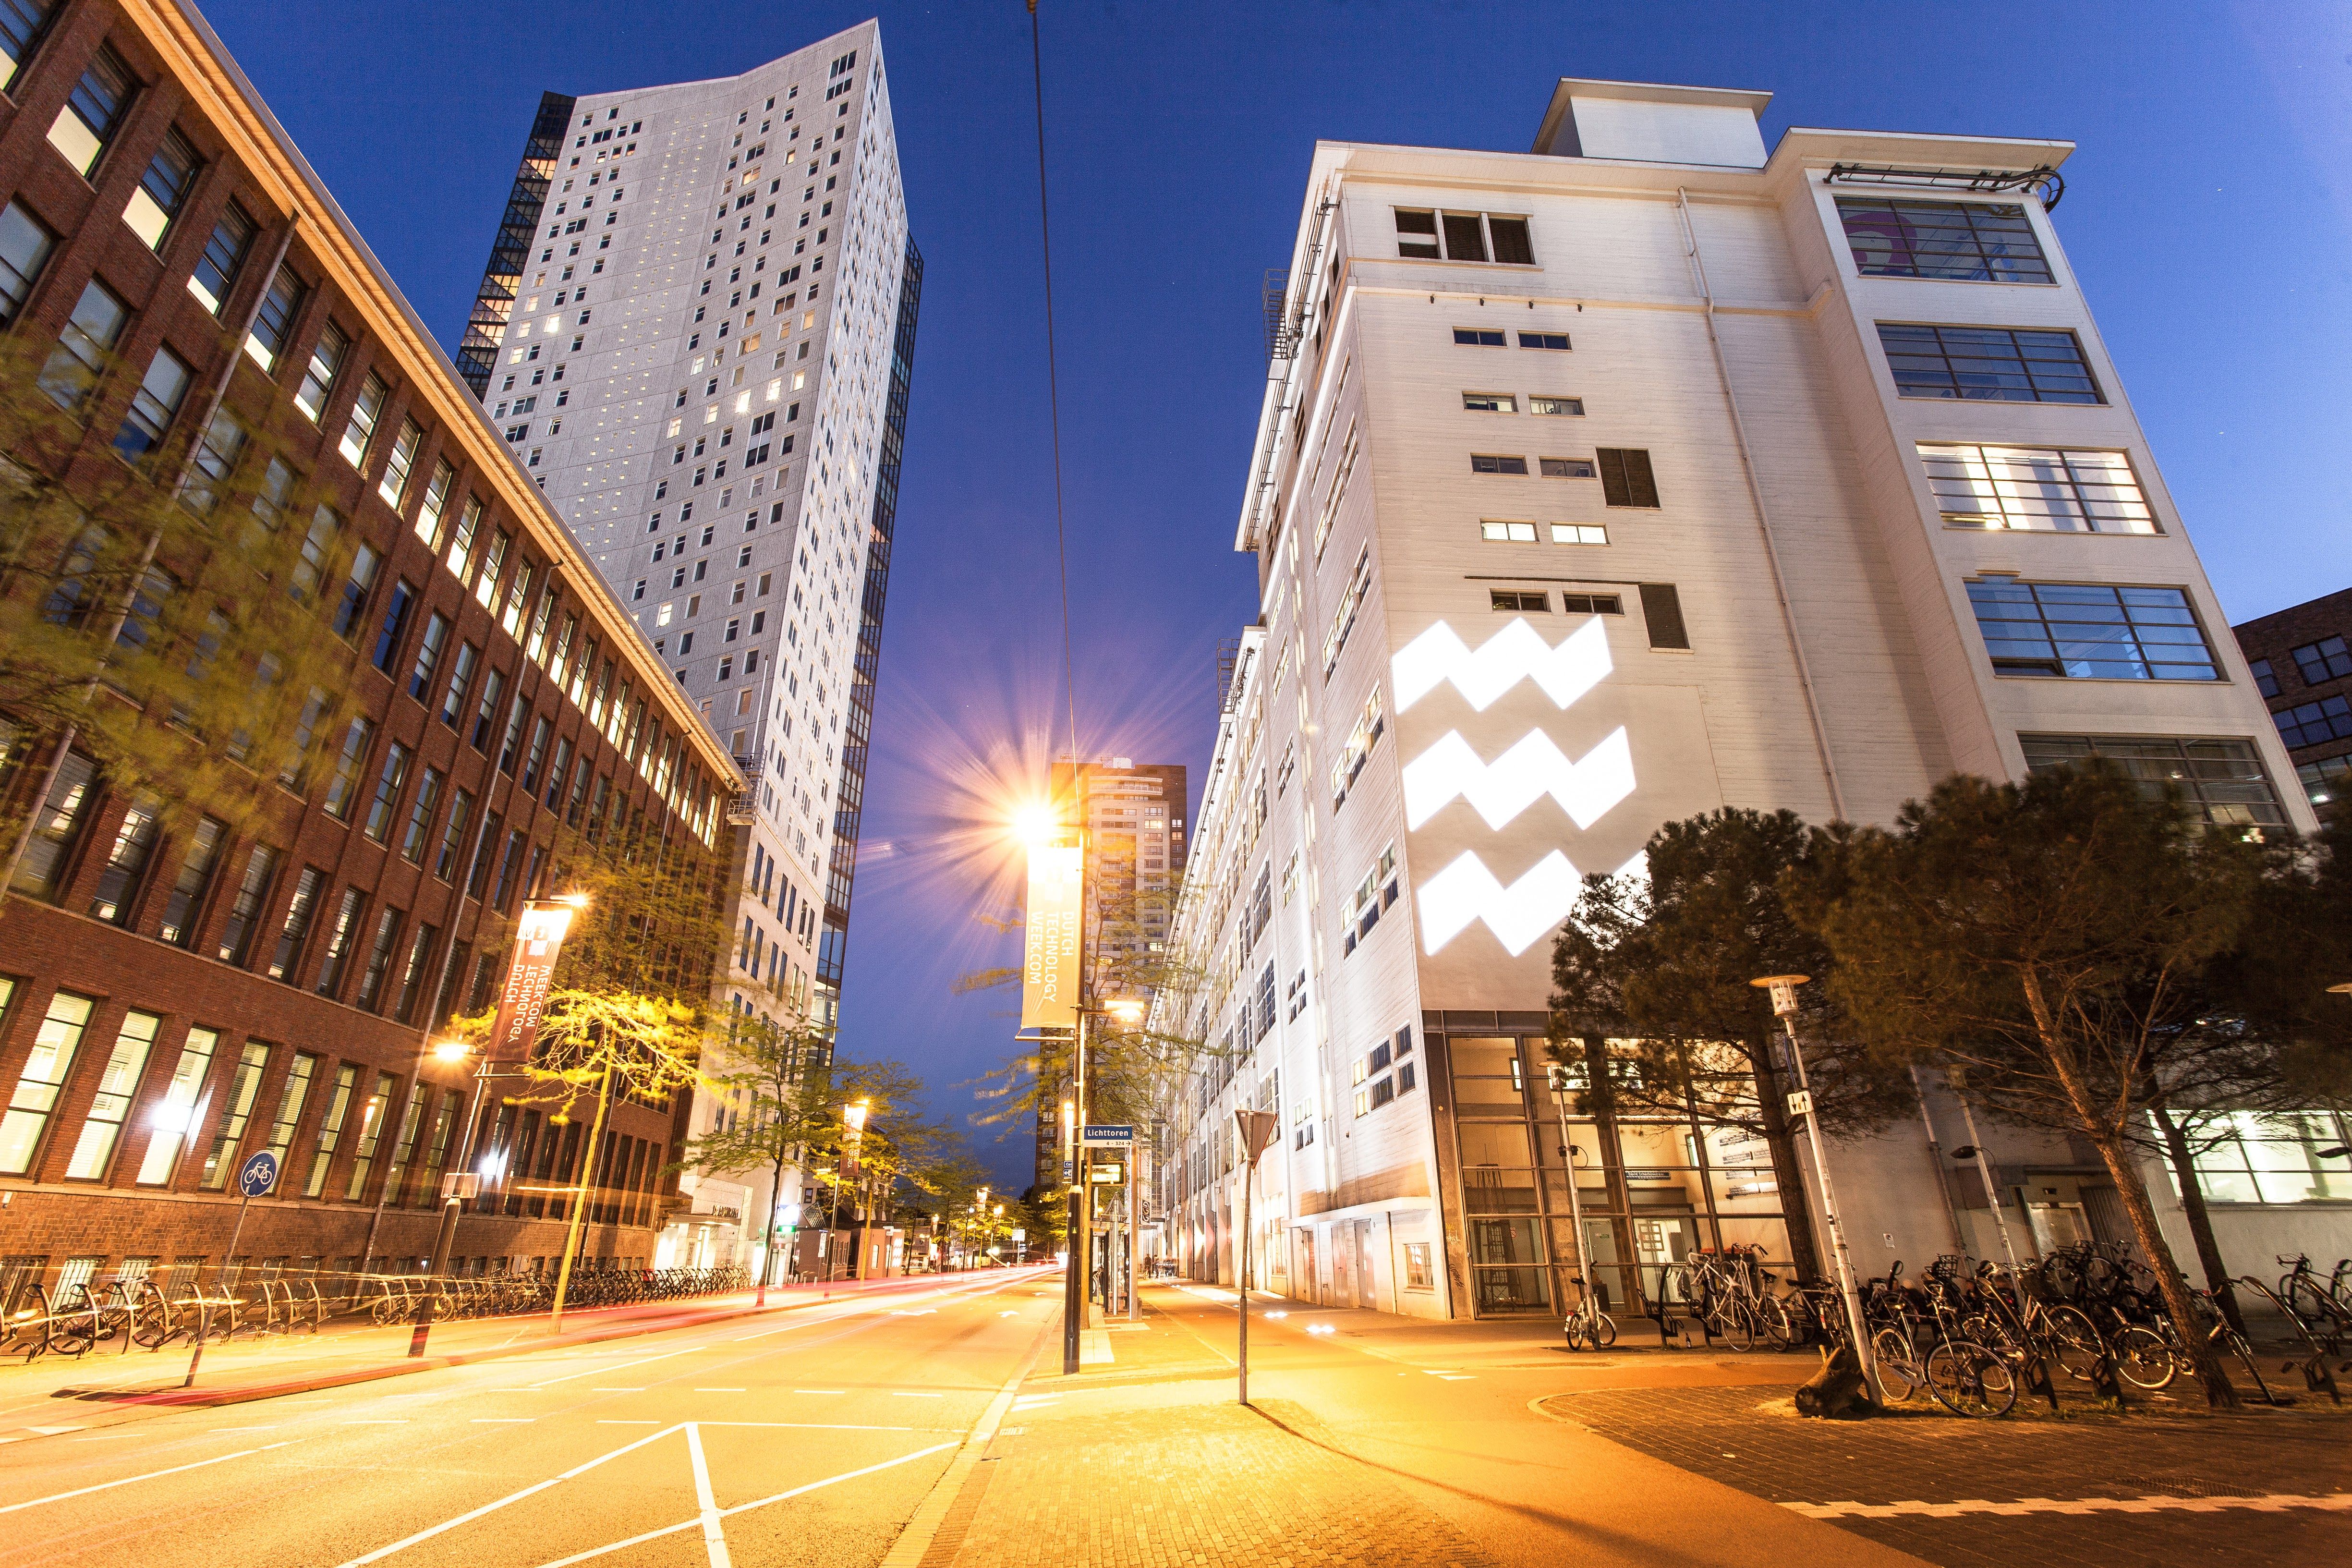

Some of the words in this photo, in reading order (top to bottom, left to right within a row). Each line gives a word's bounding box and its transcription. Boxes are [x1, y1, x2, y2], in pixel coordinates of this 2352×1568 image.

[1029, 911, 1043, 984] WEEK.COM
[1044, 912, 1059, 1002] TECHNOLOGY
[1062, 912, 1074, 956] DUTCH
